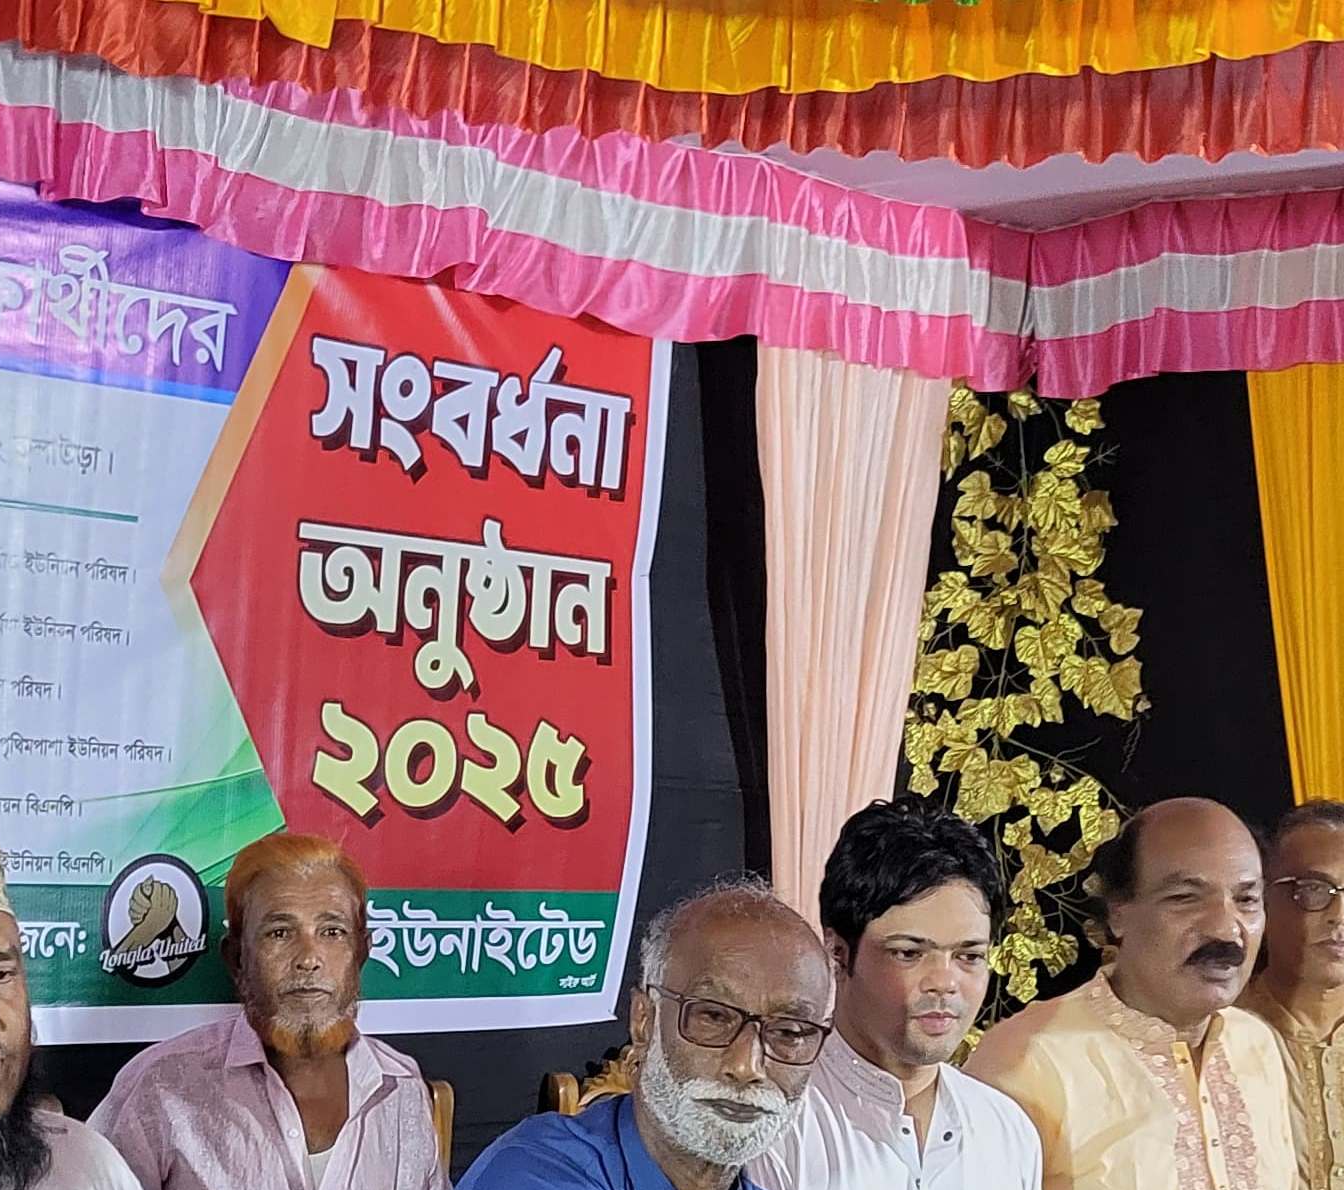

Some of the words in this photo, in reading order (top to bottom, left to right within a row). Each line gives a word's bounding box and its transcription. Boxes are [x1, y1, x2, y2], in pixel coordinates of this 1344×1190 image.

[311, 336, 632, 491] সংবর্ধনা
[298, 517, 613, 692] অনুষ্ঠান
[67, 737, 119, 760] ইউনিয়ন
[312, 701, 586, 824] ২০২৫
[100, 941, 154, 972] Longla
[154, 933, 207, 960] United
[366, 900, 606, 977] ইউনাইটেড
